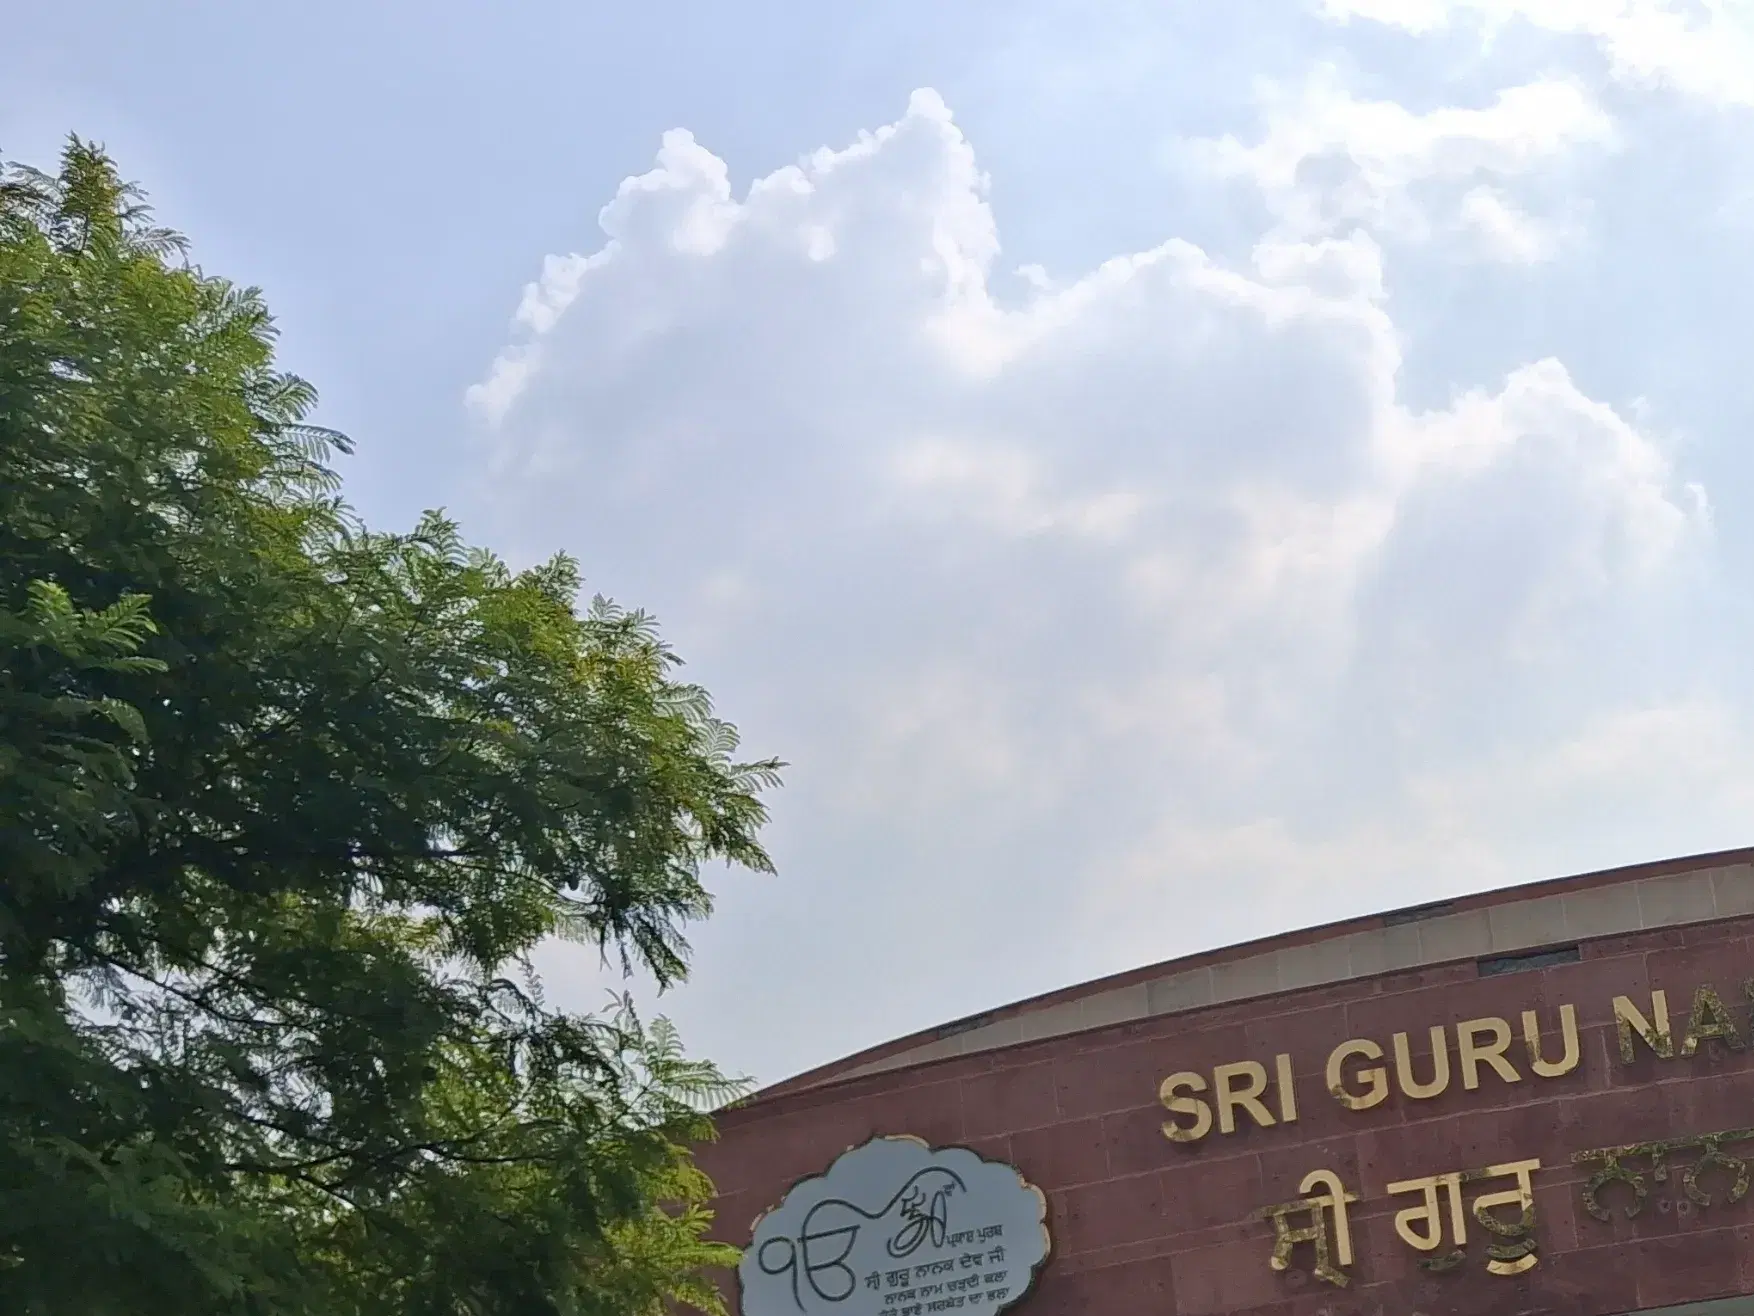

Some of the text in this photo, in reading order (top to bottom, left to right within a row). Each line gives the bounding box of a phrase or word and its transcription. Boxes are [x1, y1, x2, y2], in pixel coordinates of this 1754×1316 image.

[1159, 1053, 1299, 1143] SRI
[1325, 1003, 1582, 1112] GURU
[914, 1258, 956, 1279] ਨਾਨਕ
[987, 1244, 1008, 1265] ਜੀ
[1258, 1168, 1360, 1289] ਸ੍ਰੀ
[1386, 1157, 1541, 1276] ਗੁਰੂ
